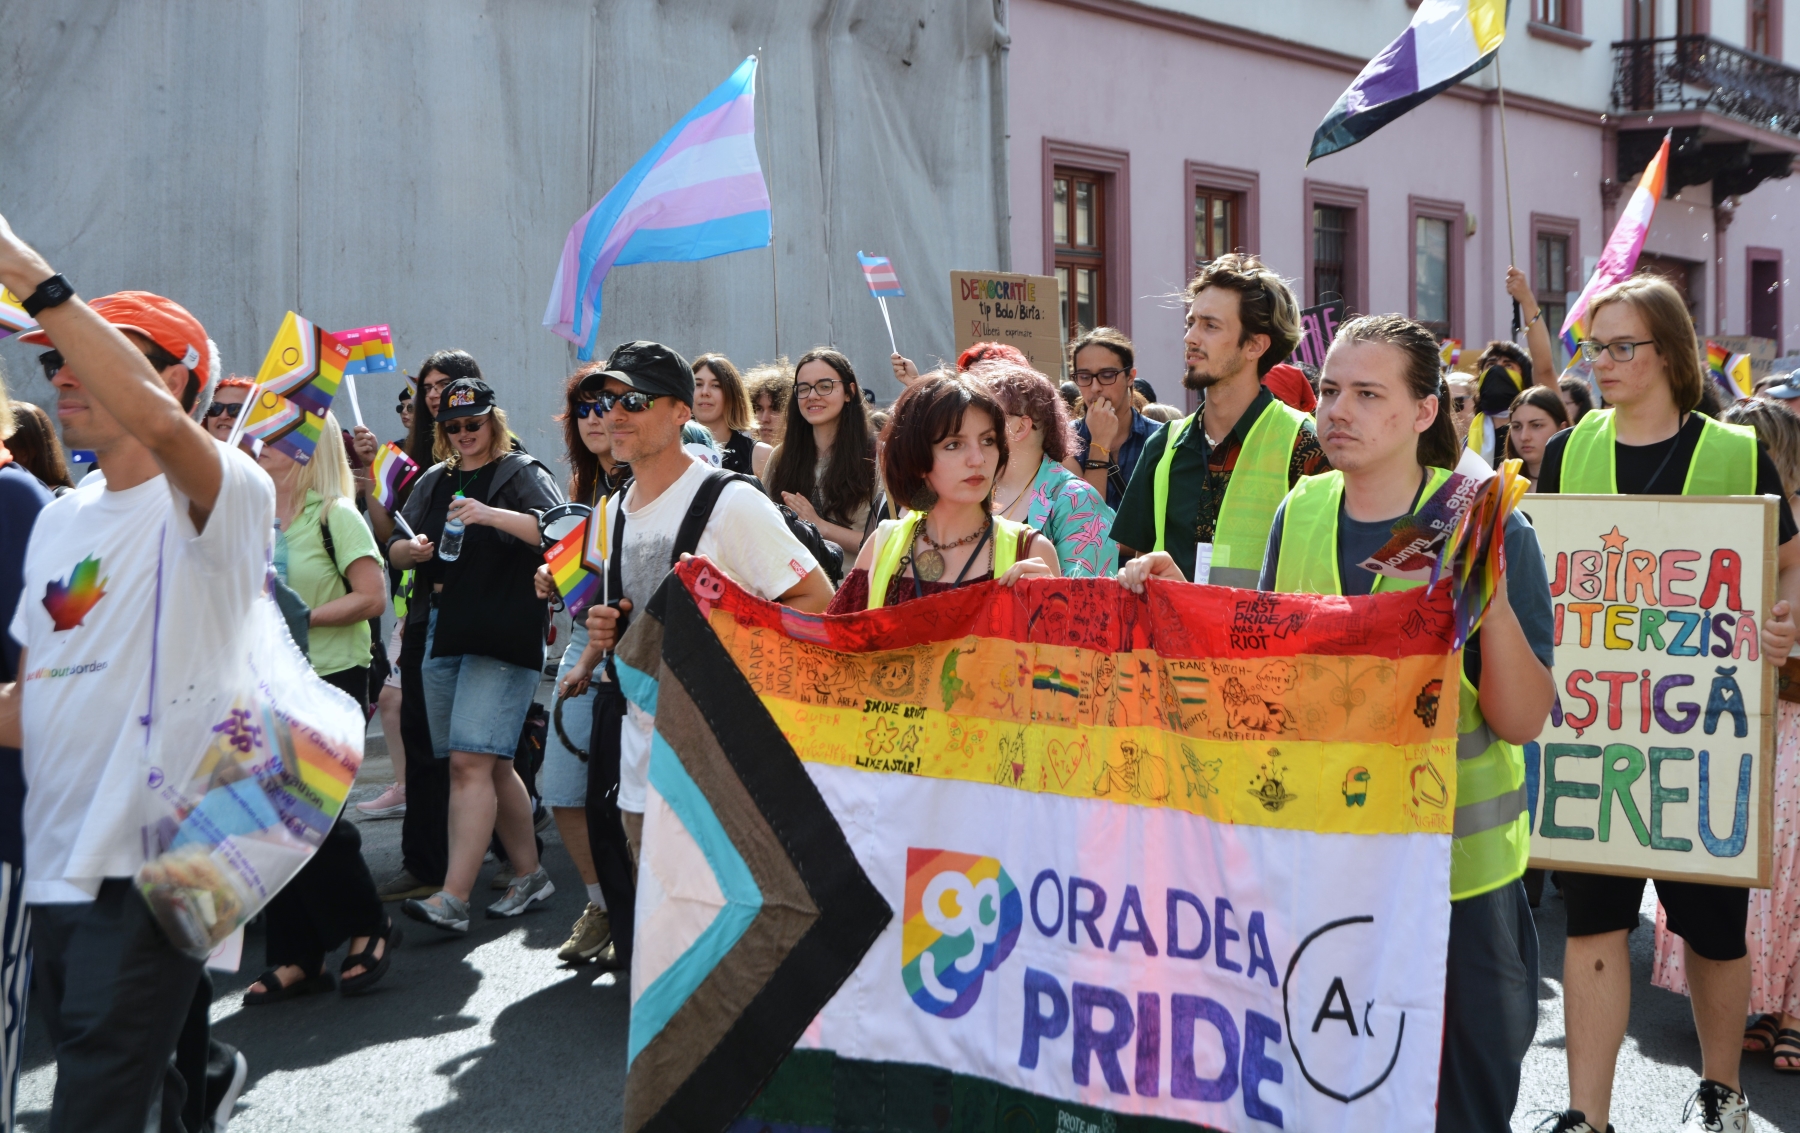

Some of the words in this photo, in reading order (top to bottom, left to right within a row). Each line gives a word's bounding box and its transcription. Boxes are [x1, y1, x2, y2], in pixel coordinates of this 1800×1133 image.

[1446, 476, 1476, 509] este
[1549, 548, 1742, 611] UBIREA
[1236, 601, 1281, 613] FIRST
[1230, 625, 1253, 633] WAS
[1256, 625, 1265, 633] A
[1234, 612, 1280, 625] PRIDE
[1554, 602, 1760, 661] TERZISĂ
[1230, 634, 1270, 651] RIOT
[749, 629, 765, 694] ORADEA
[1170, 661, 1206, 672] TRANS
[1260, 674, 1290, 684] WOMEN
[800, 694, 811, 703] IN
[817, 696, 828, 705] UR
[837, 697, 858, 707] AREA
[863, 699, 900, 715] SHINE
[1550, 665, 1748, 739] ȘTIGĂ
[795, 709, 840, 726] QUEER
[1182, 709, 1207, 731] RIGHTS
[796, 745, 856, 766] NYWHERE
[1523, 741, 1753, 857] EREU
[1030, 868, 1279, 988] ORADEA
[1018, 966, 1285, 1130] PRIDE
